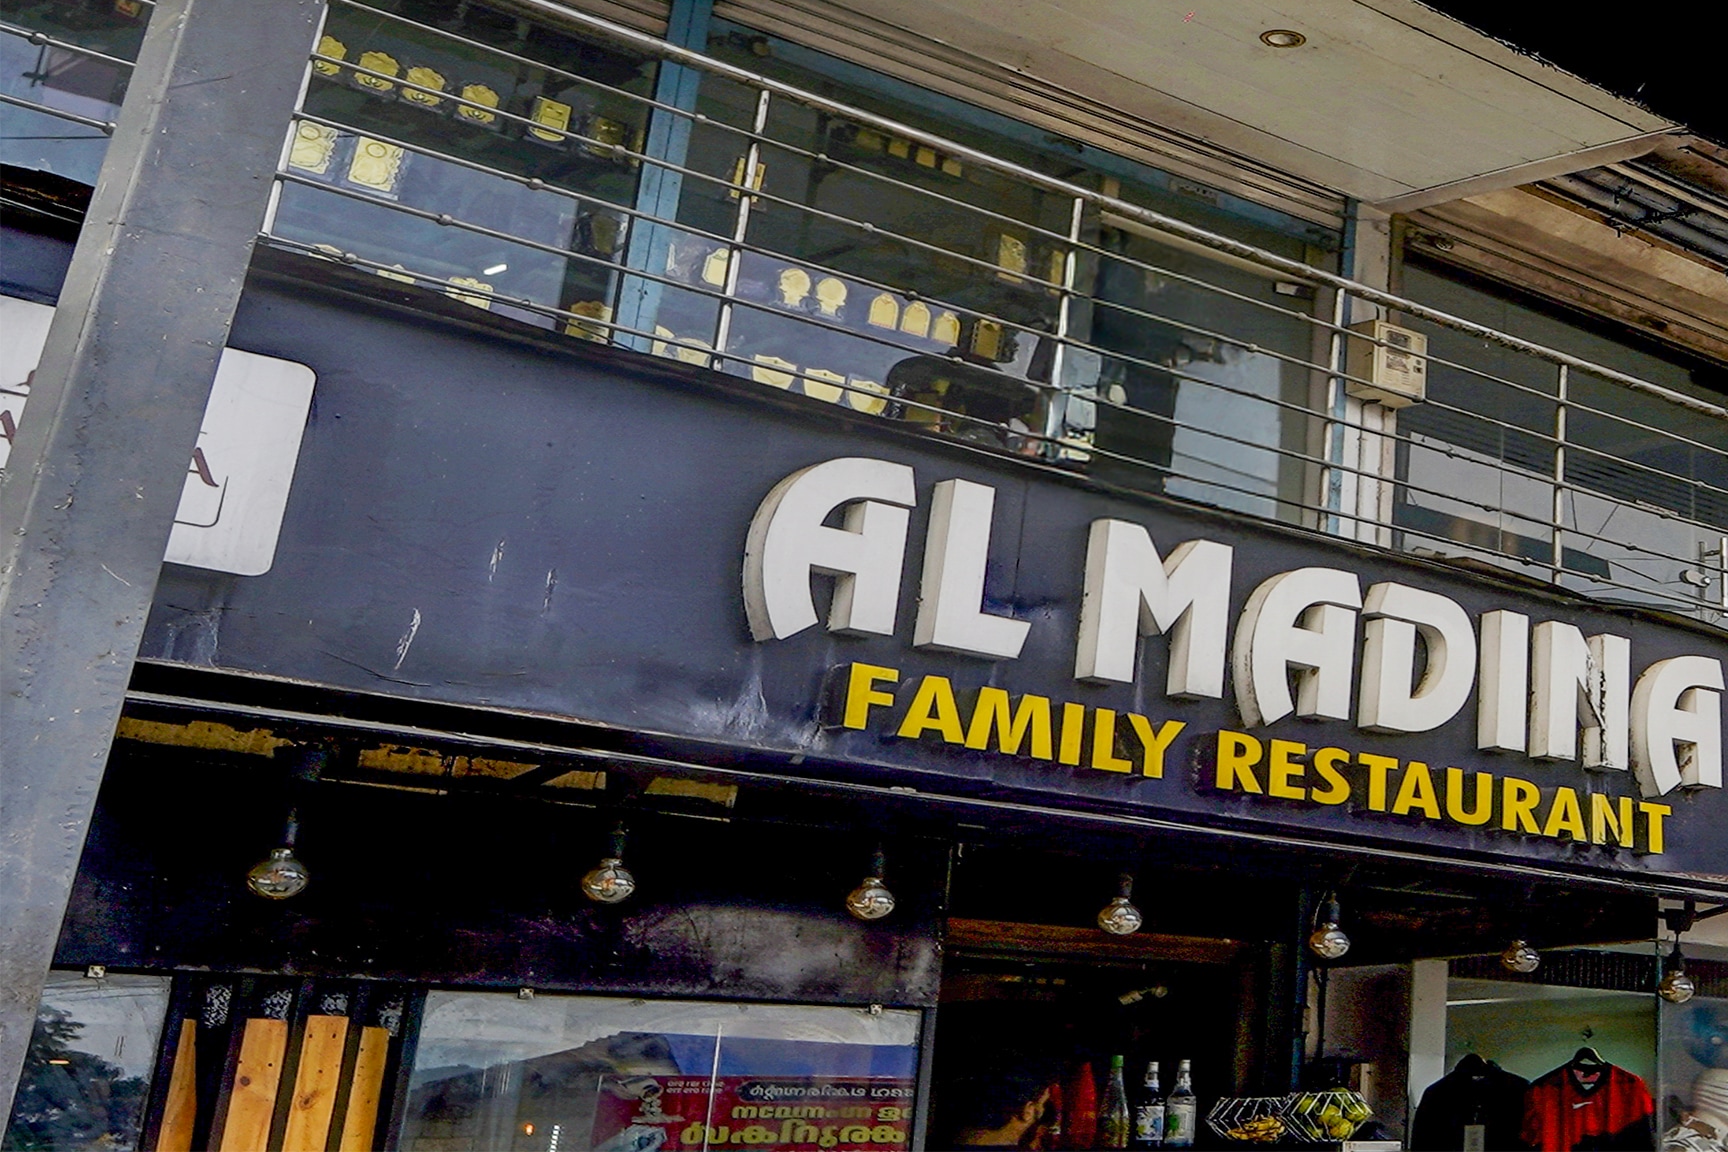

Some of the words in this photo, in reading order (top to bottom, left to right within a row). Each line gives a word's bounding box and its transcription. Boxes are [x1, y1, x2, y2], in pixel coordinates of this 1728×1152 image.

[743, 456, 1033, 660] AL
[1074, 516, 1727, 798] MADINA
[836, 661, 1188, 780] FAMILY
[1212, 728, 1673, 856] RESTAURANT
